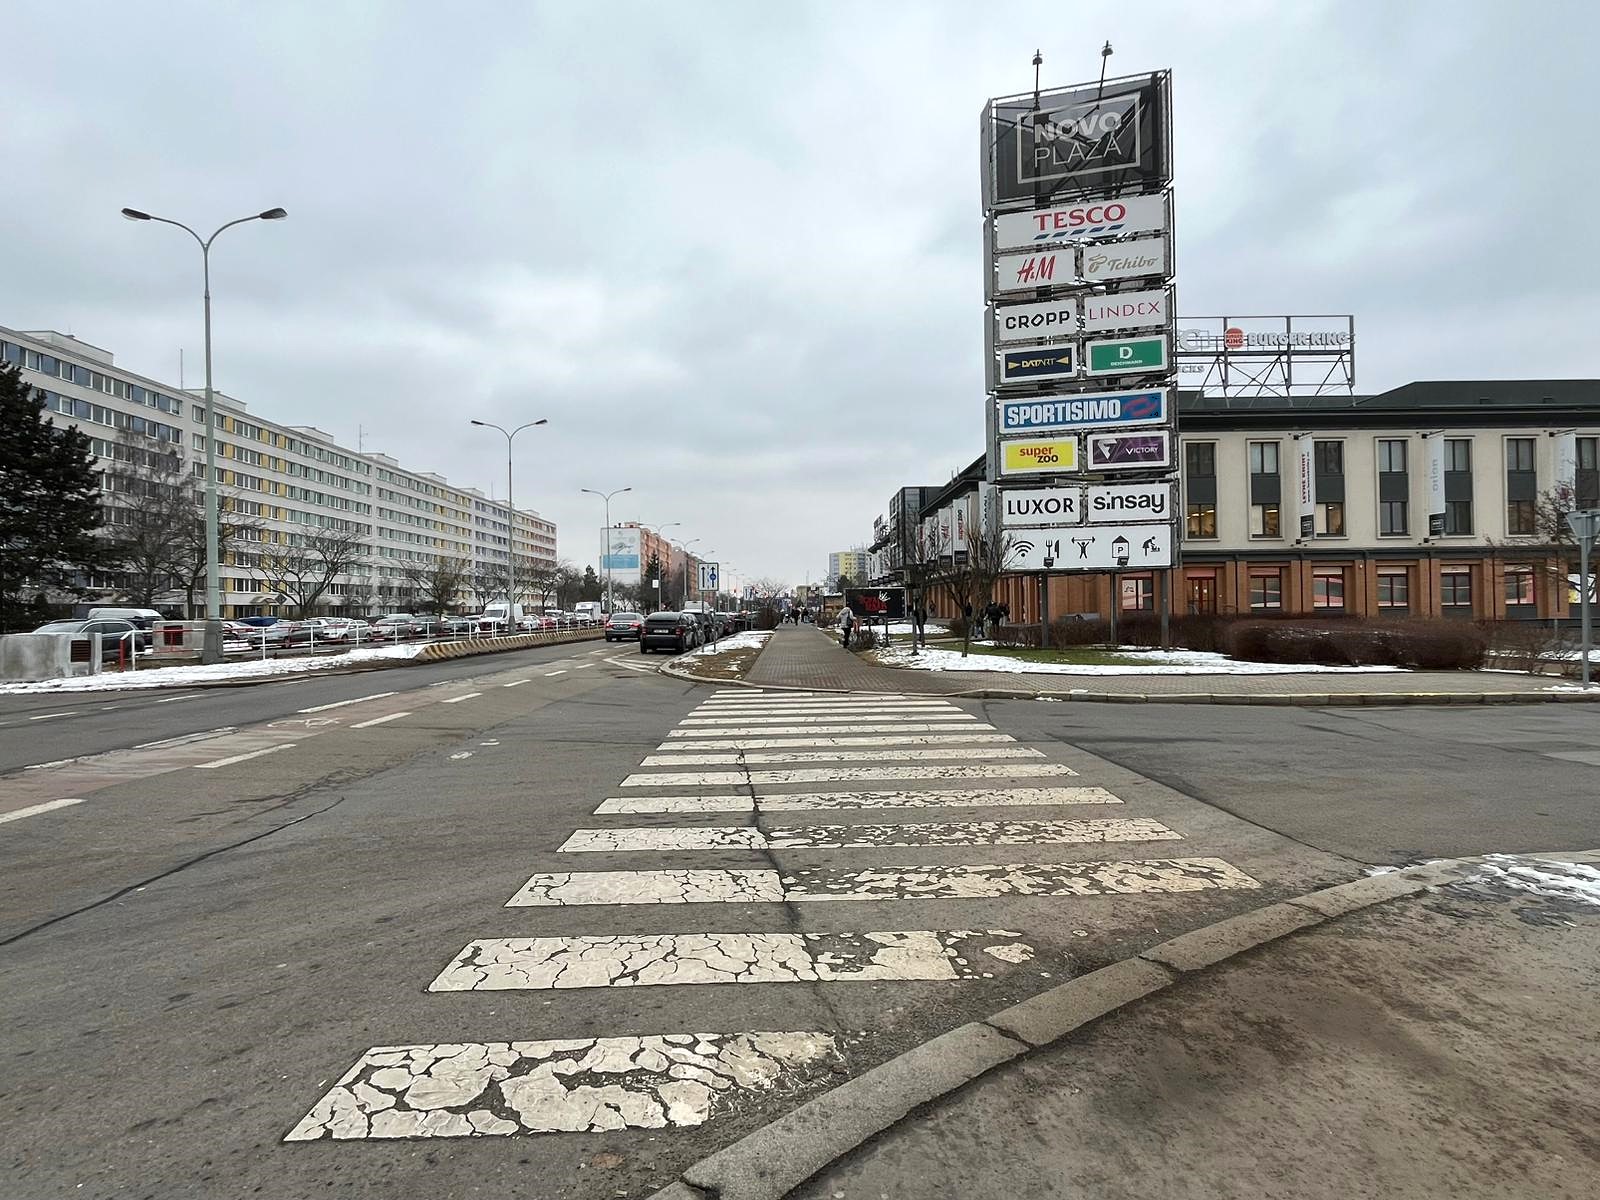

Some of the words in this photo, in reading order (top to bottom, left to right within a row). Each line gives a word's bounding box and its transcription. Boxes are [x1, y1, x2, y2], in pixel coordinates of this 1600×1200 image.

[1034, 112, 1122, 143] NOVO
[1034, 131, 1122, 168] PLAZA
[1033, 204, 1126, 230] TESCO
[1017, 255, 1056, 283] H&M
[1107, 256, 1158, 272] Tchibo
[1089, 301, 1160, 320] LINDEX
[1006, 311, 1070, 329] CROPP
[1247, 332, 1309, 346] BURGER
[1310, 331, 1350, 346] KING
[1120, 347, 1133, 359] D
[1021, 358, 1056, 368] DATART
[1008, 400, 1121, 425] SPORTISIMO
[1020, 446, 1053, 456] super
[1037, 454, 1058, 463] zoo
[1126, 447, 1158, 455] VICTORY
[1007, 498, 1074, 515] LUXOR
[1093, 491, 1164, 513] sinsay
